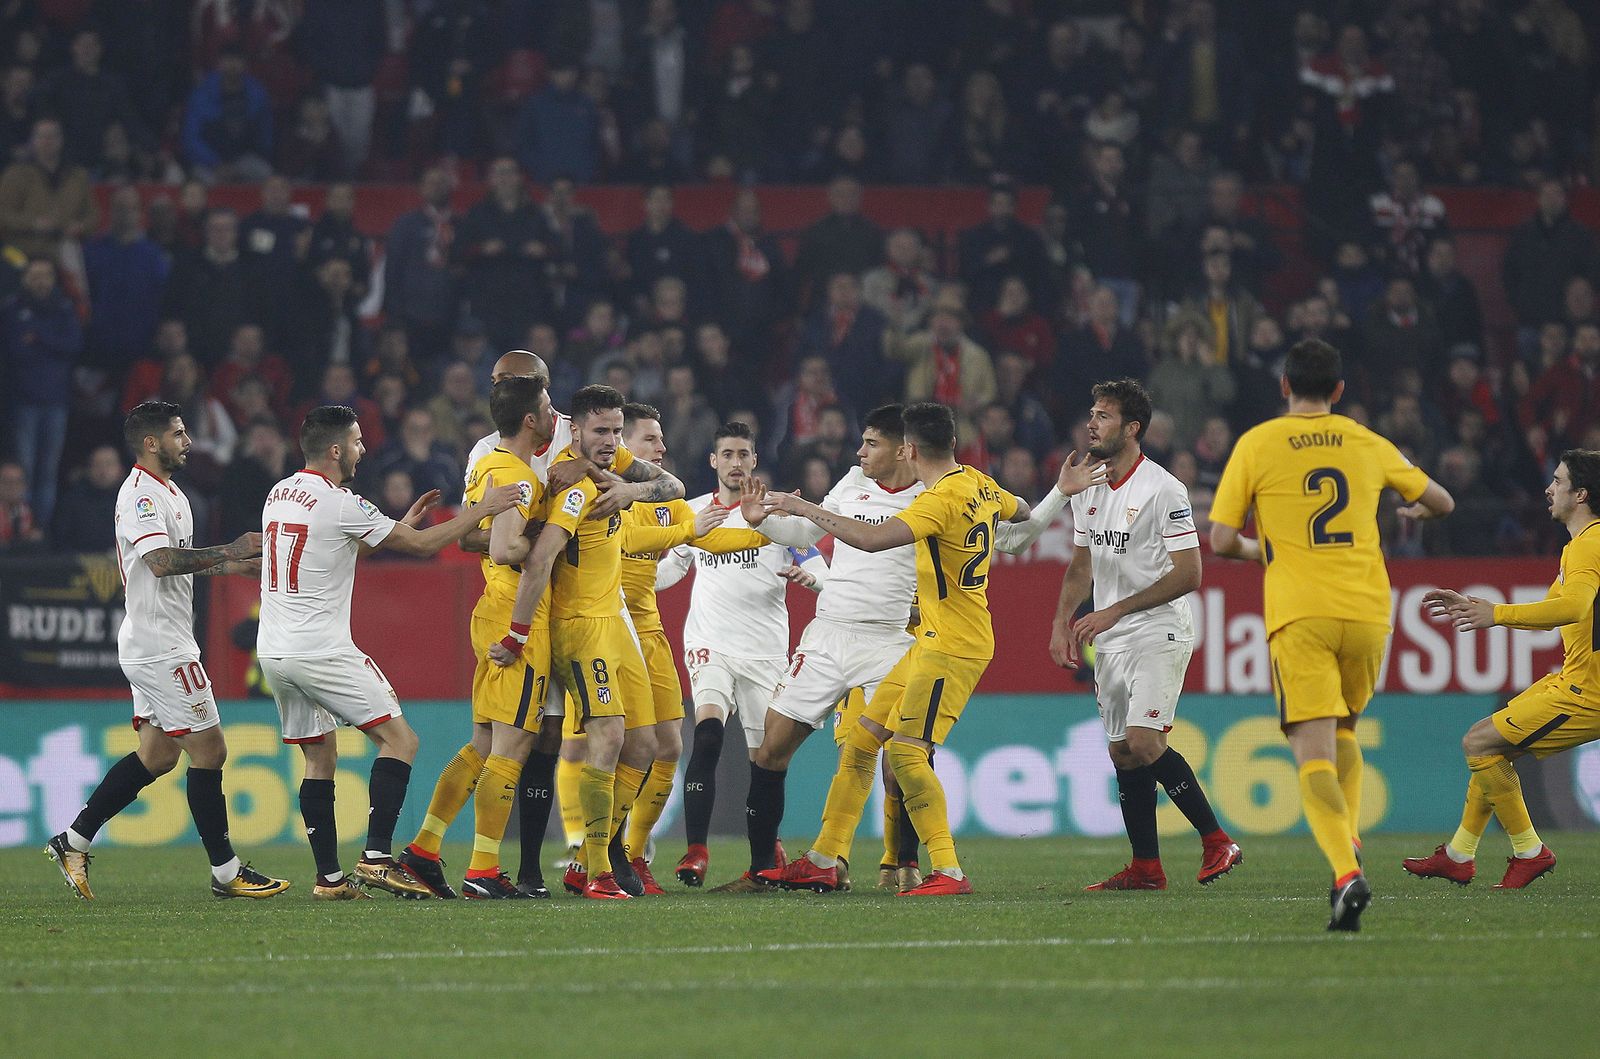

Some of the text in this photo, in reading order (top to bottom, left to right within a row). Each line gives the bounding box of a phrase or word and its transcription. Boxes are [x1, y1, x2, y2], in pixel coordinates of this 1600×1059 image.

[1289, 431, 1343, 450] GODÍN
[267, 487, 318, 512] SARABIA
[1303, 467, 1354, 548] 2
[265, 520, 309, 594] 17
[8, 604, 106, 642] RUDE
[172, 661, 208, 697] 10
[591, 657, 610, 686] 8
[526, 788, 548, 799] SFC
[686, 782, 704, 792] SFC
[1168, 780, 1189, 797] SFC
